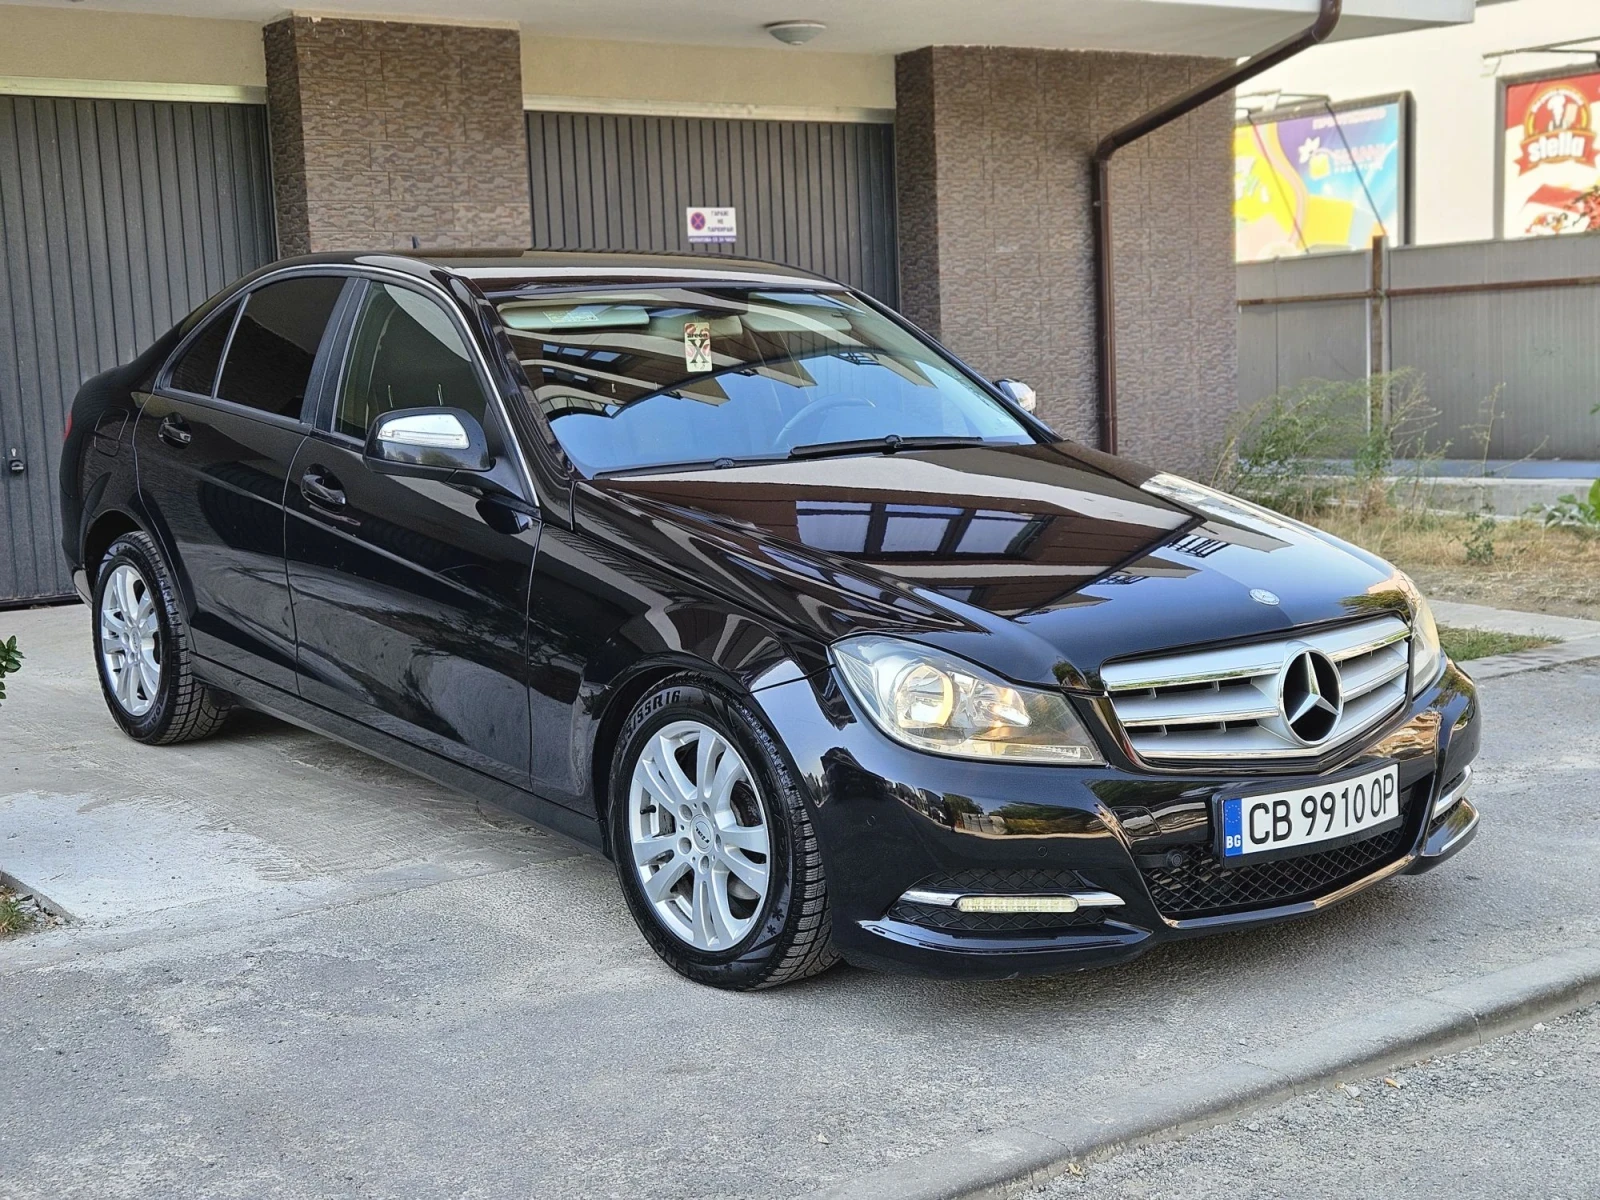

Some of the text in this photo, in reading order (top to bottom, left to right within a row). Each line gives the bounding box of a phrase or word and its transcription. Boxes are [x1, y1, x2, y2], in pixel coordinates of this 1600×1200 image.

[1527, 131, 1585, 162] stella
[1300, 783, 1366, 837] 9910
[1226, 835, 1242, 849] BG
